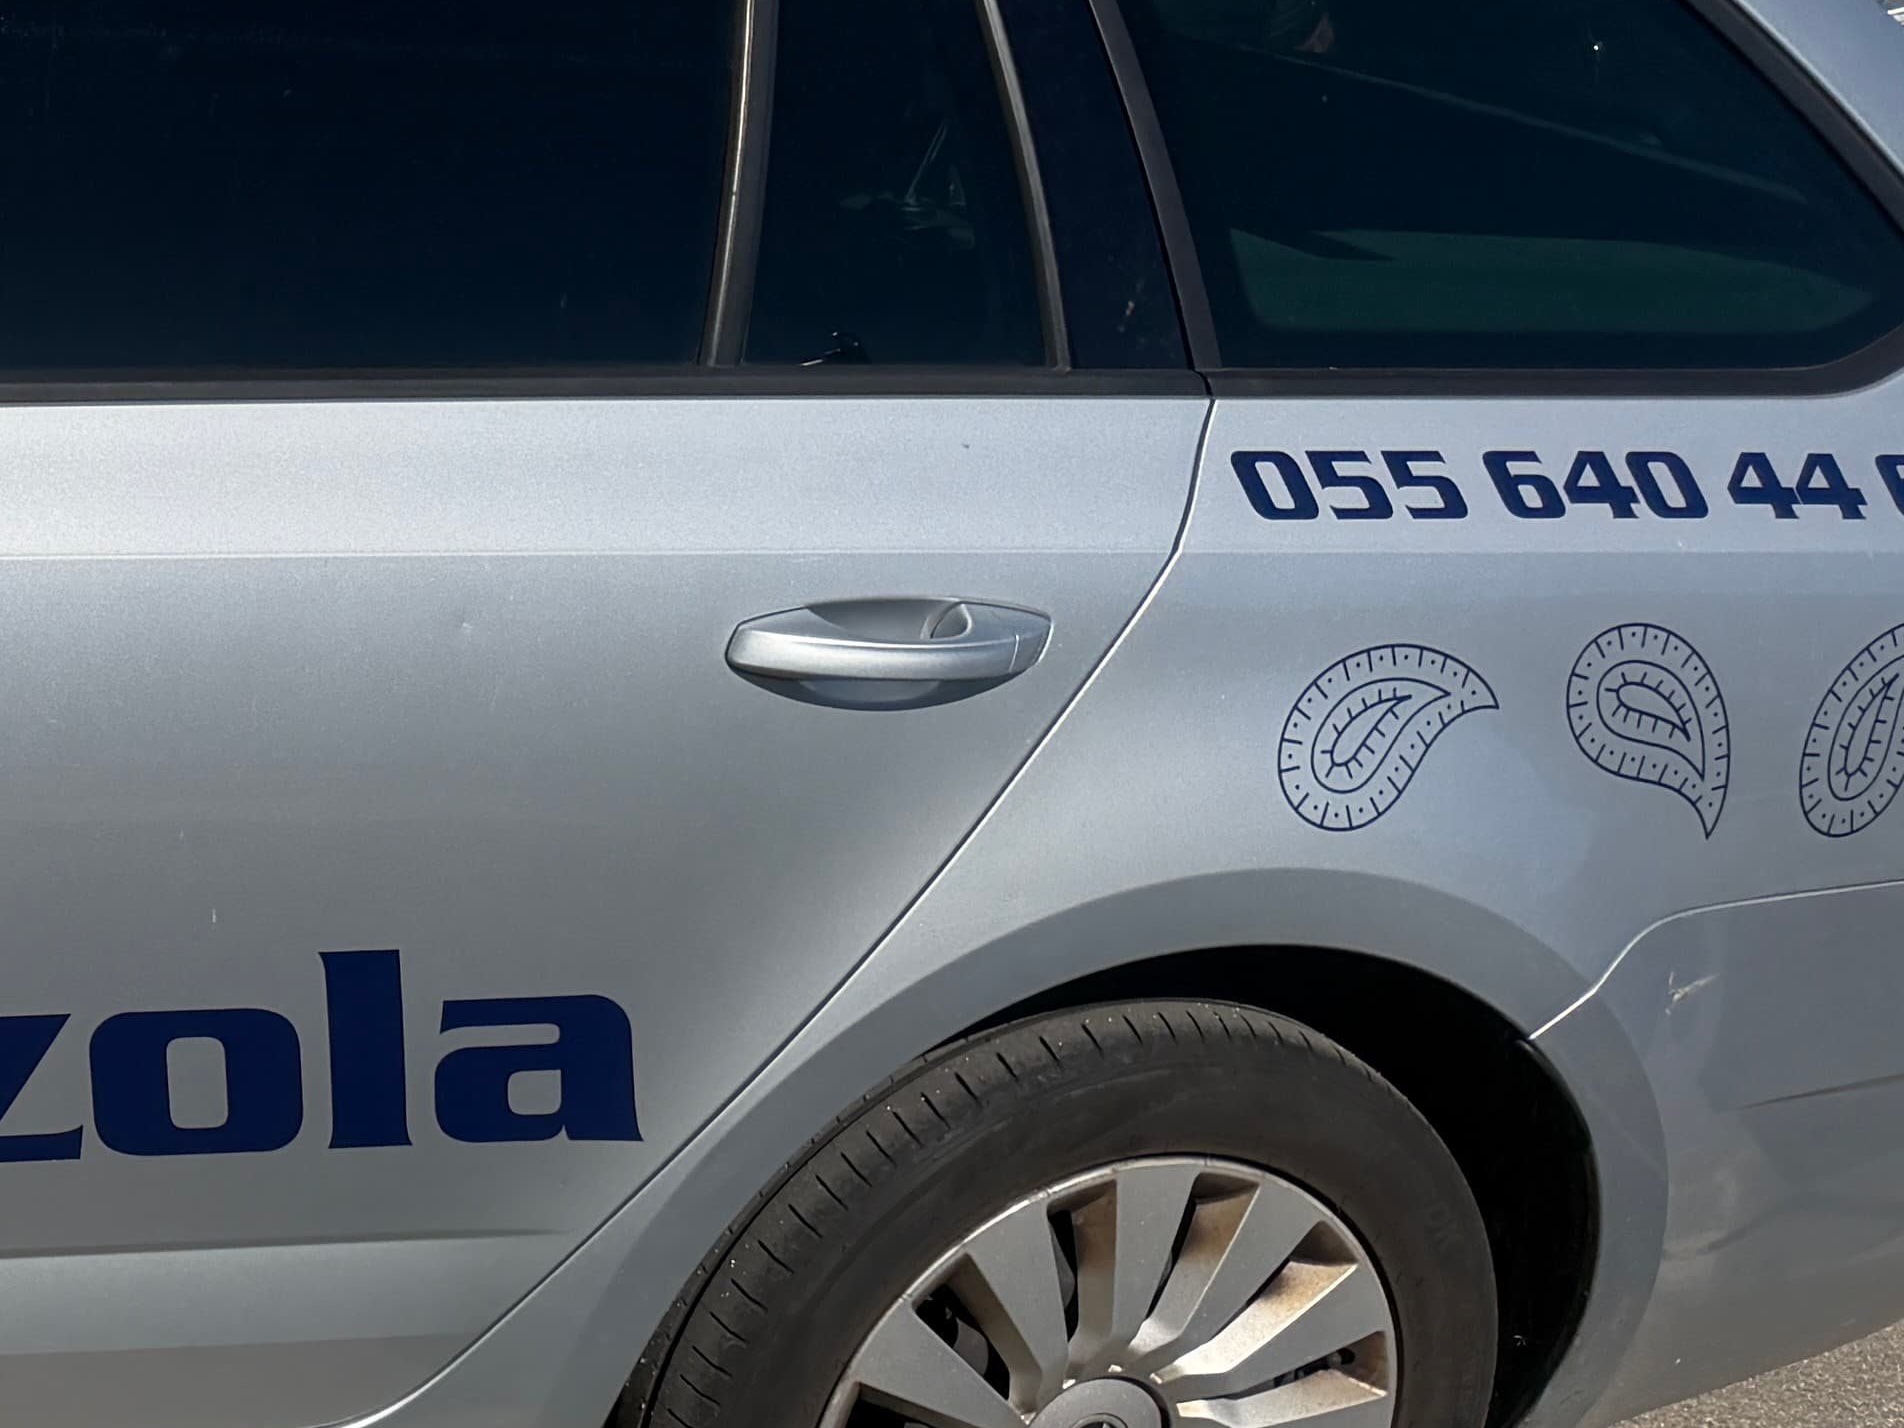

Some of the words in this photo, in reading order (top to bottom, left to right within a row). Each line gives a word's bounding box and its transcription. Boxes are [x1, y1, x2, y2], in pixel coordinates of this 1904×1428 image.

[1230, 450, 1468, 520] 055
[1482, 450, 1710, 520] 640
[1727, 451, 1868, 521] 44
